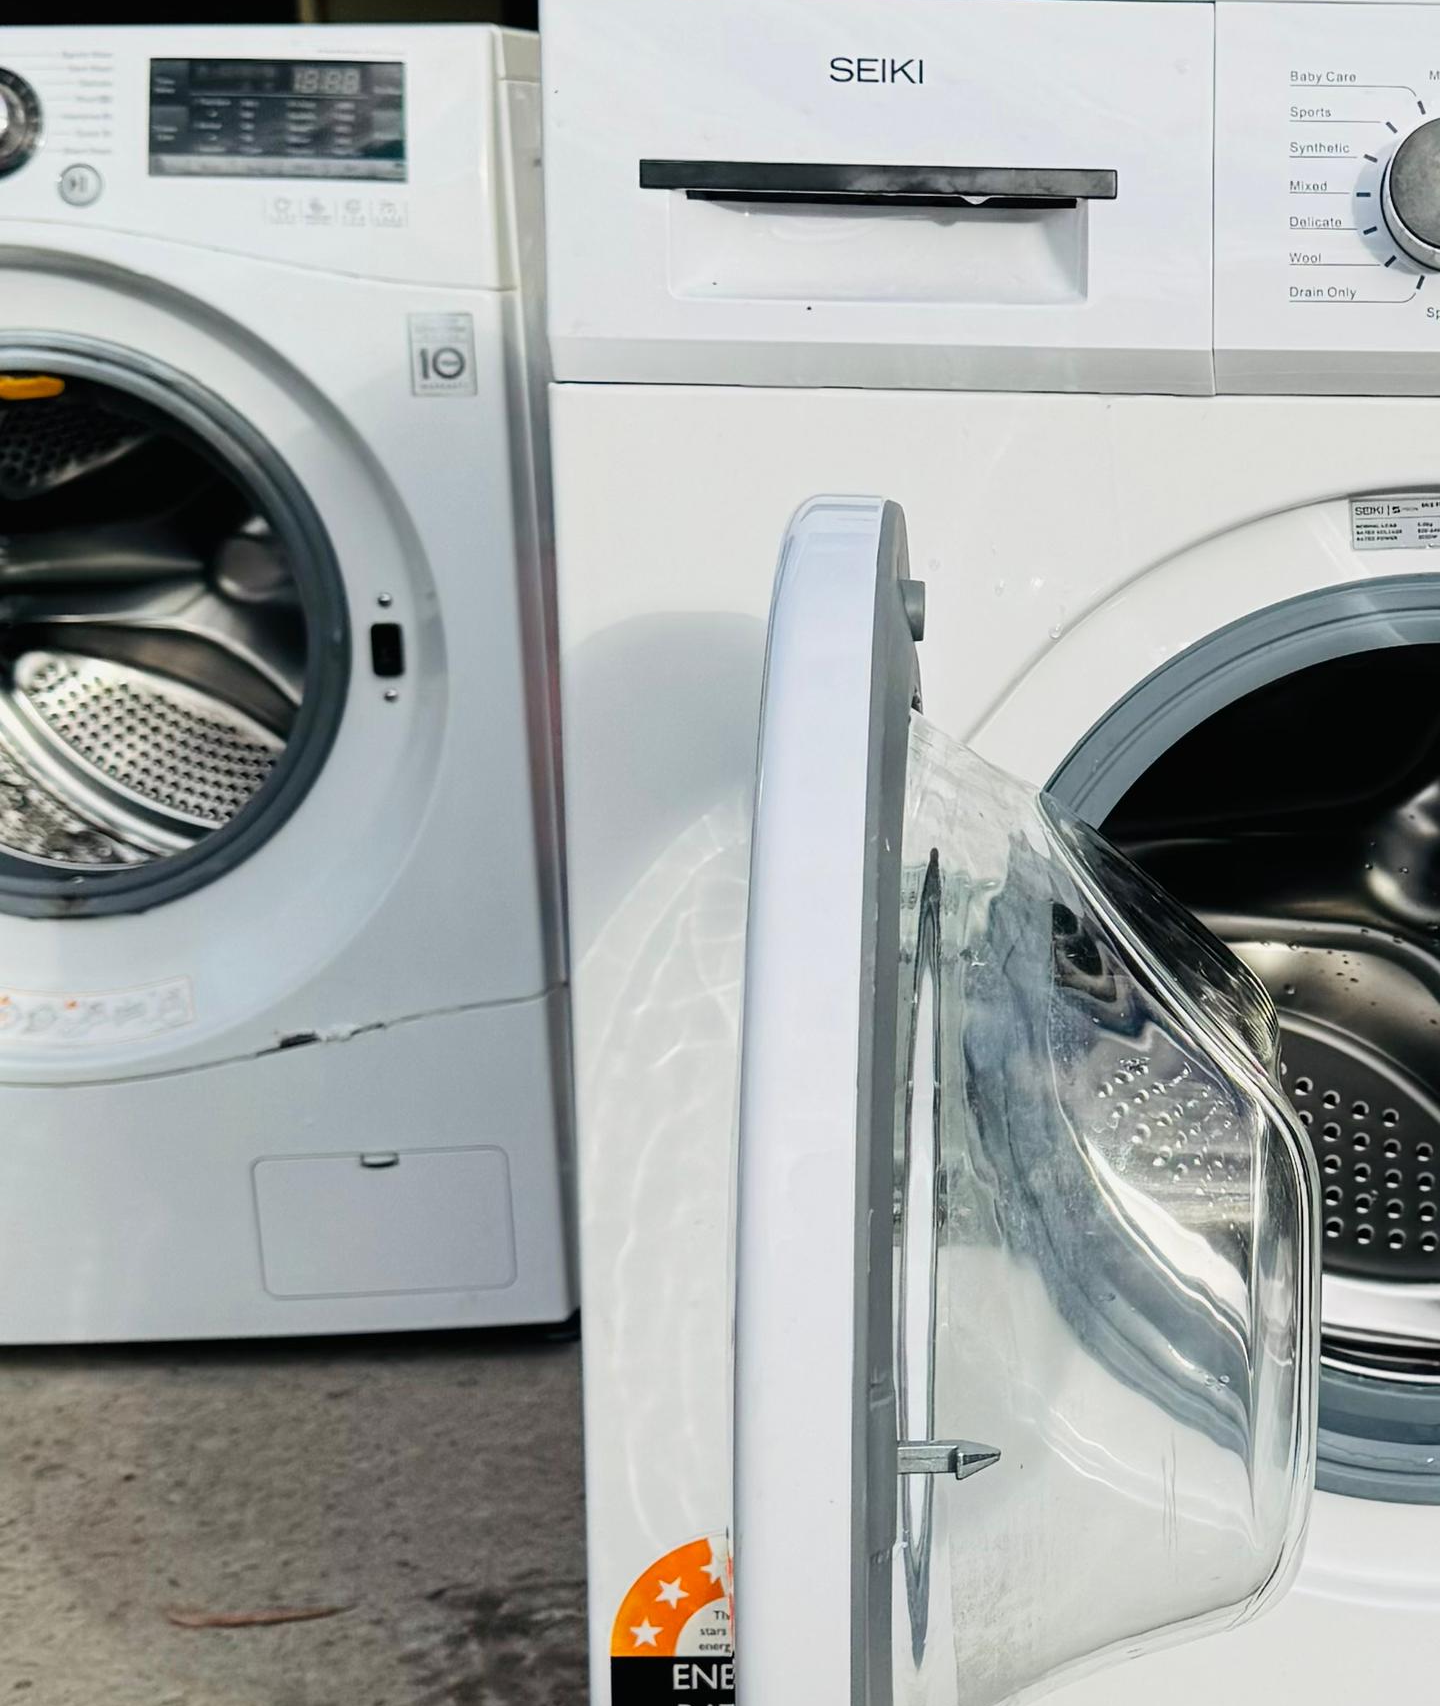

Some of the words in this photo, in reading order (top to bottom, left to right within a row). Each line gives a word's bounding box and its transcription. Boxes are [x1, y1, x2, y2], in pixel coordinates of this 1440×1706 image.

[829, 57, 923, 84] SEIKI
[1290, 71, 1322, 83] Baby
[1326, 71, 1356, 82] Care
[1290, 106, 1331, 118] Sports
[1290, 141, 1350, 154] Synthetic
[1290, 181, 1327, 192] Mixed
[1290, 216, 1342, 227] Delicate
[1290, 252, 1321, 263] Wool
[1290, 286, 1323, 297] Drain
[1328, 286, 1356, 300] Only
[700, 1628, 726, 1636] stars
